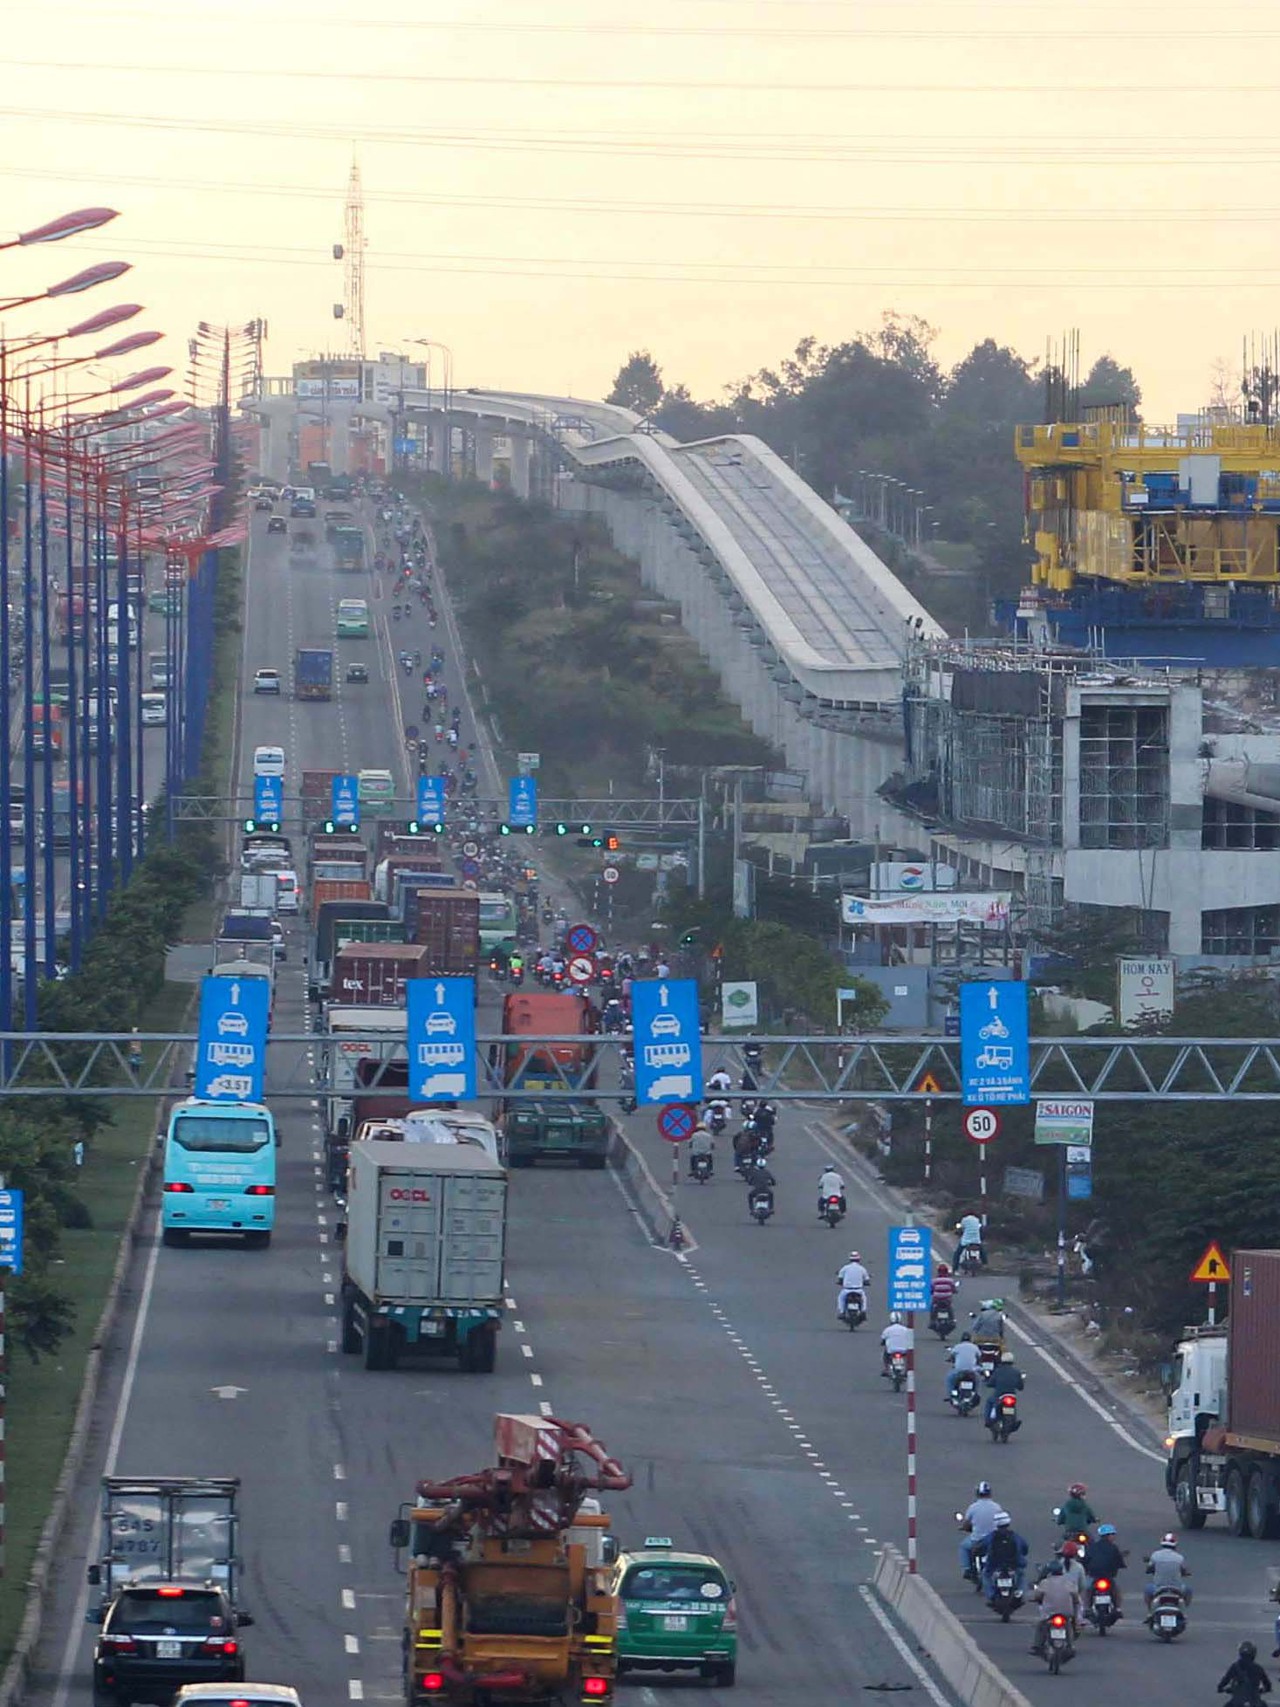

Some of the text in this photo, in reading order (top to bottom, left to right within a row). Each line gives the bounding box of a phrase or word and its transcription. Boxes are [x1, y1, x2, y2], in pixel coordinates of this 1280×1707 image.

[1149, 963, 1171, 974] NAY
[342, 978, 364, 990] tex
[1045, 1104, 1091, 1115] SAIGON
[972, 1116, 991, 1132] 50
